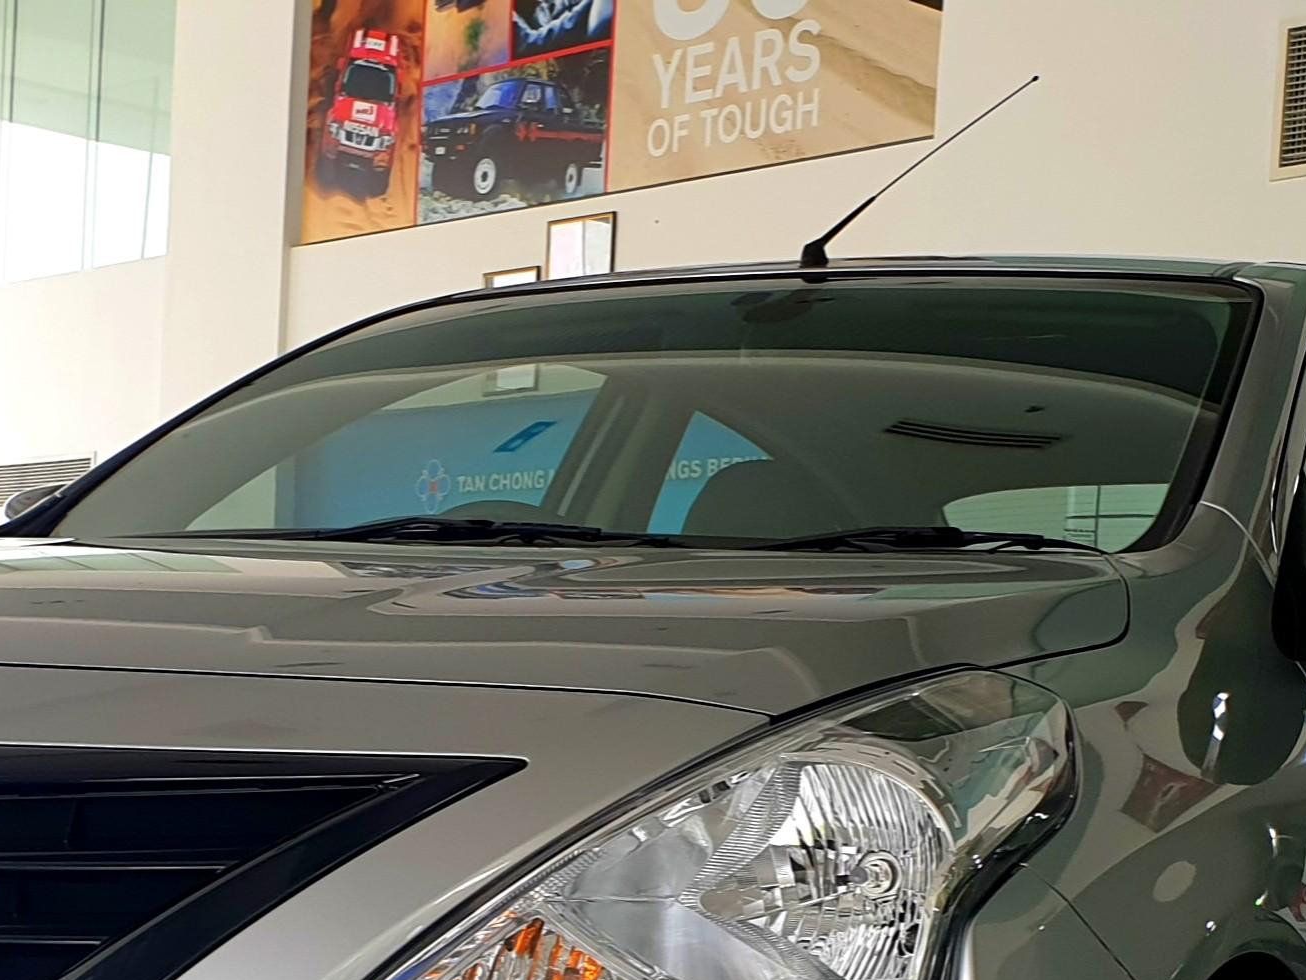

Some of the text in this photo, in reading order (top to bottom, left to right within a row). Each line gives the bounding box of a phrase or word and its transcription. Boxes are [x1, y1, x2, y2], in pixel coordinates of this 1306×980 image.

[652, 19, 821, 109] YEARS
[647, 88, 820, 157] OF TOUGH
[457, 475, 487, 493] TAN
[488, 470, 544, 492] CHONG
